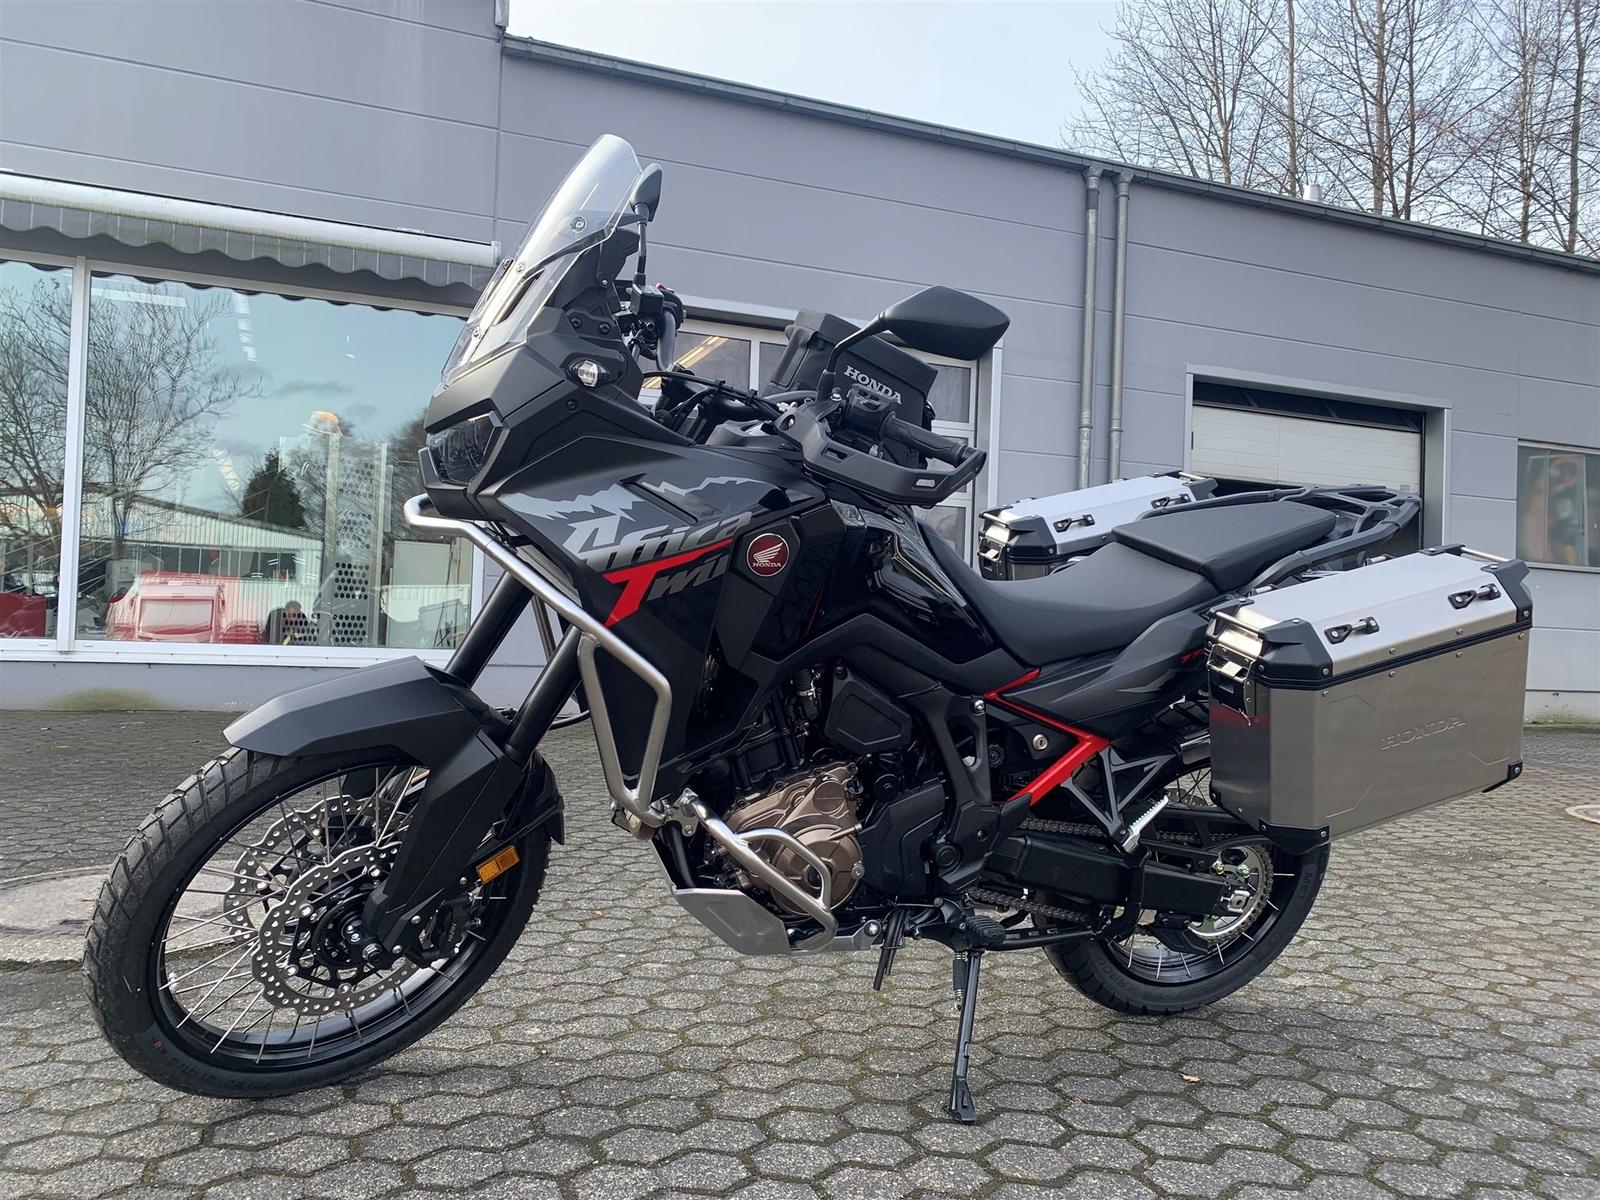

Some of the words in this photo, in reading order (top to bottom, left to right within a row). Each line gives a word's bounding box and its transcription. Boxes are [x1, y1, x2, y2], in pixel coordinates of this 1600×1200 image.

[843, 364, 902, 405] HONDA
[562, 511, 753, 573] Africa
[1380, 715, 1467, 751] HONDA
